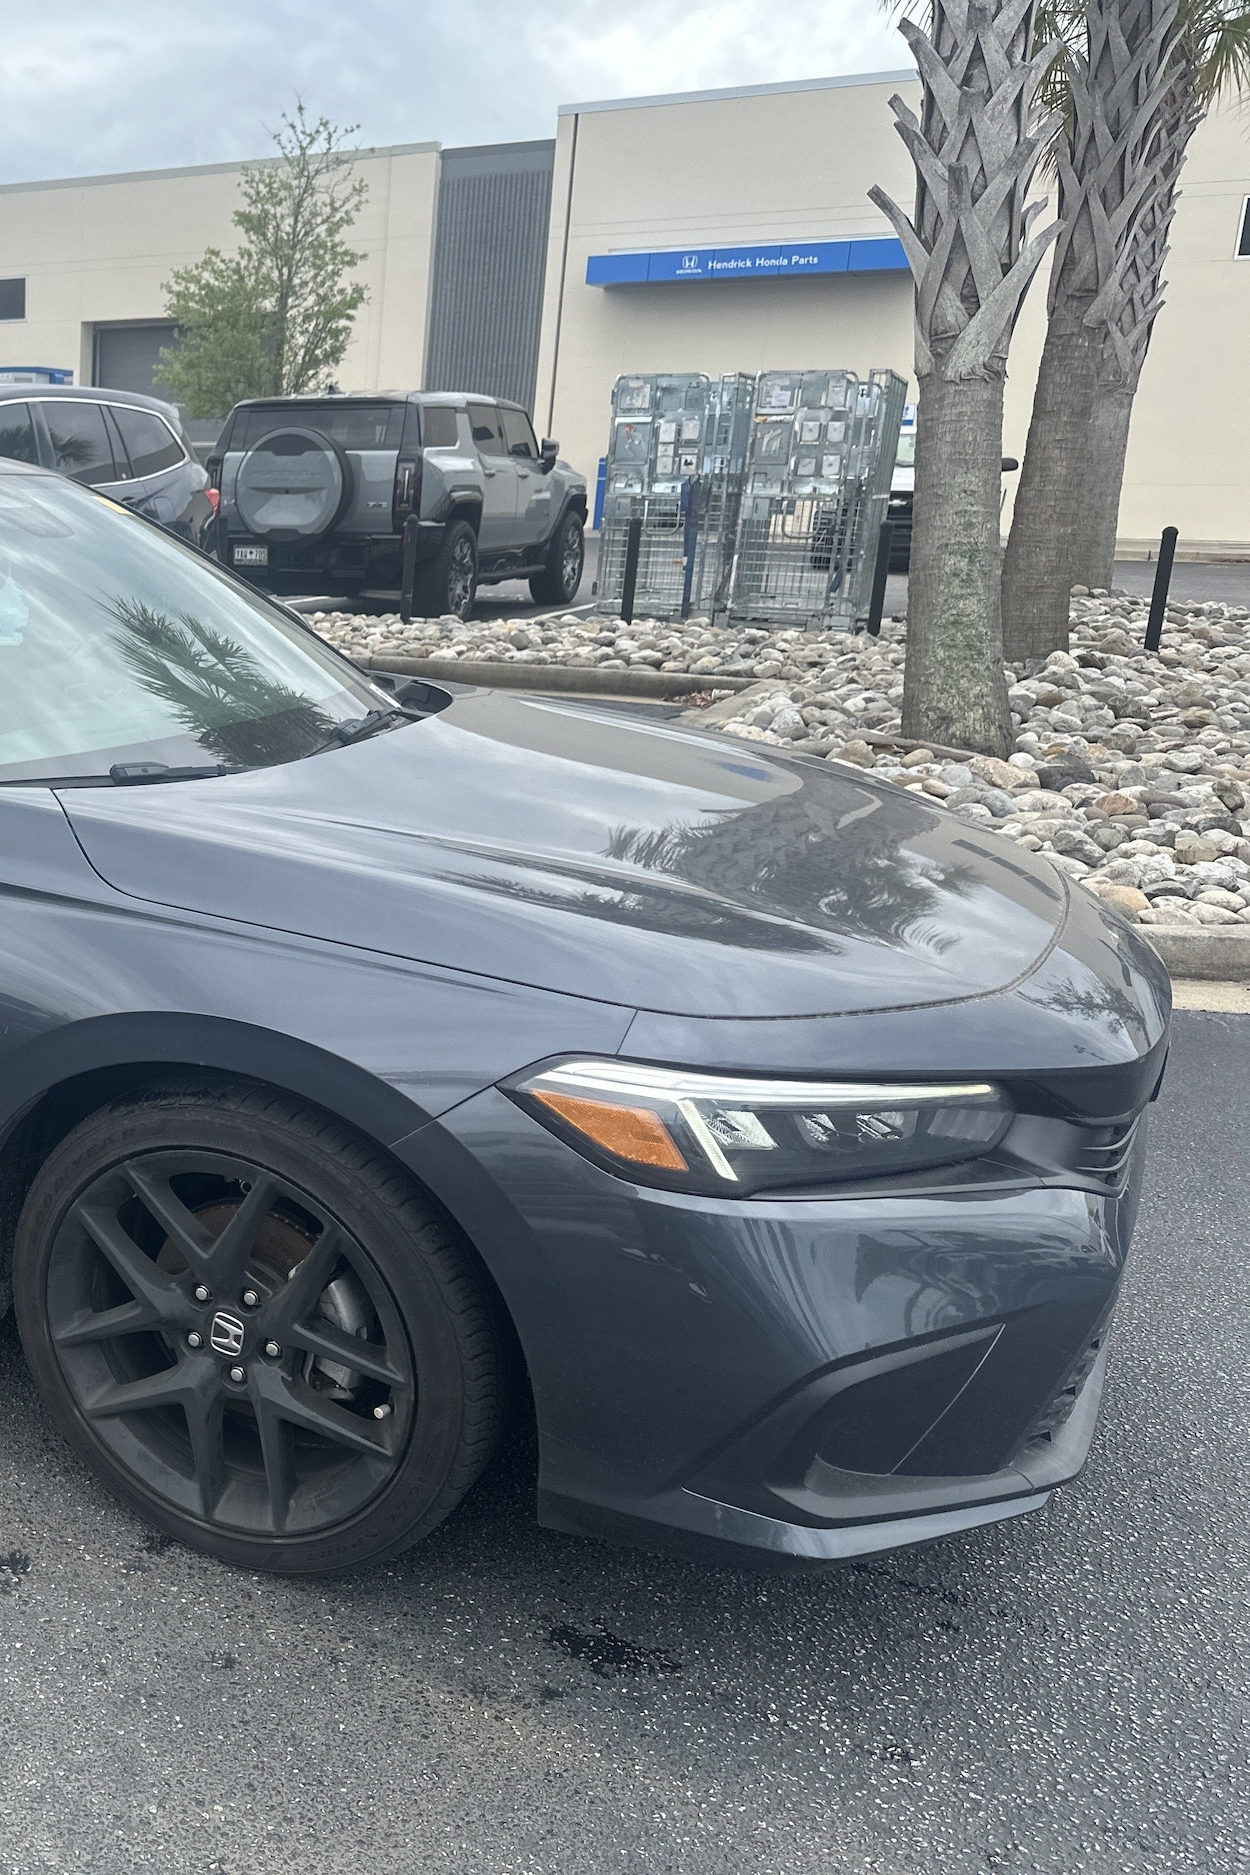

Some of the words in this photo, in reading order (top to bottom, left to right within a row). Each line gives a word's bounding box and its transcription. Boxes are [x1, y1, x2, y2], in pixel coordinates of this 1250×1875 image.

[707, 258, 753, 270] Hendrick
[755, 256, 788, 268] Honda
[790, 254, 818, 266] Parts
[29, 1128, 137, 1246] GOODYEAR
